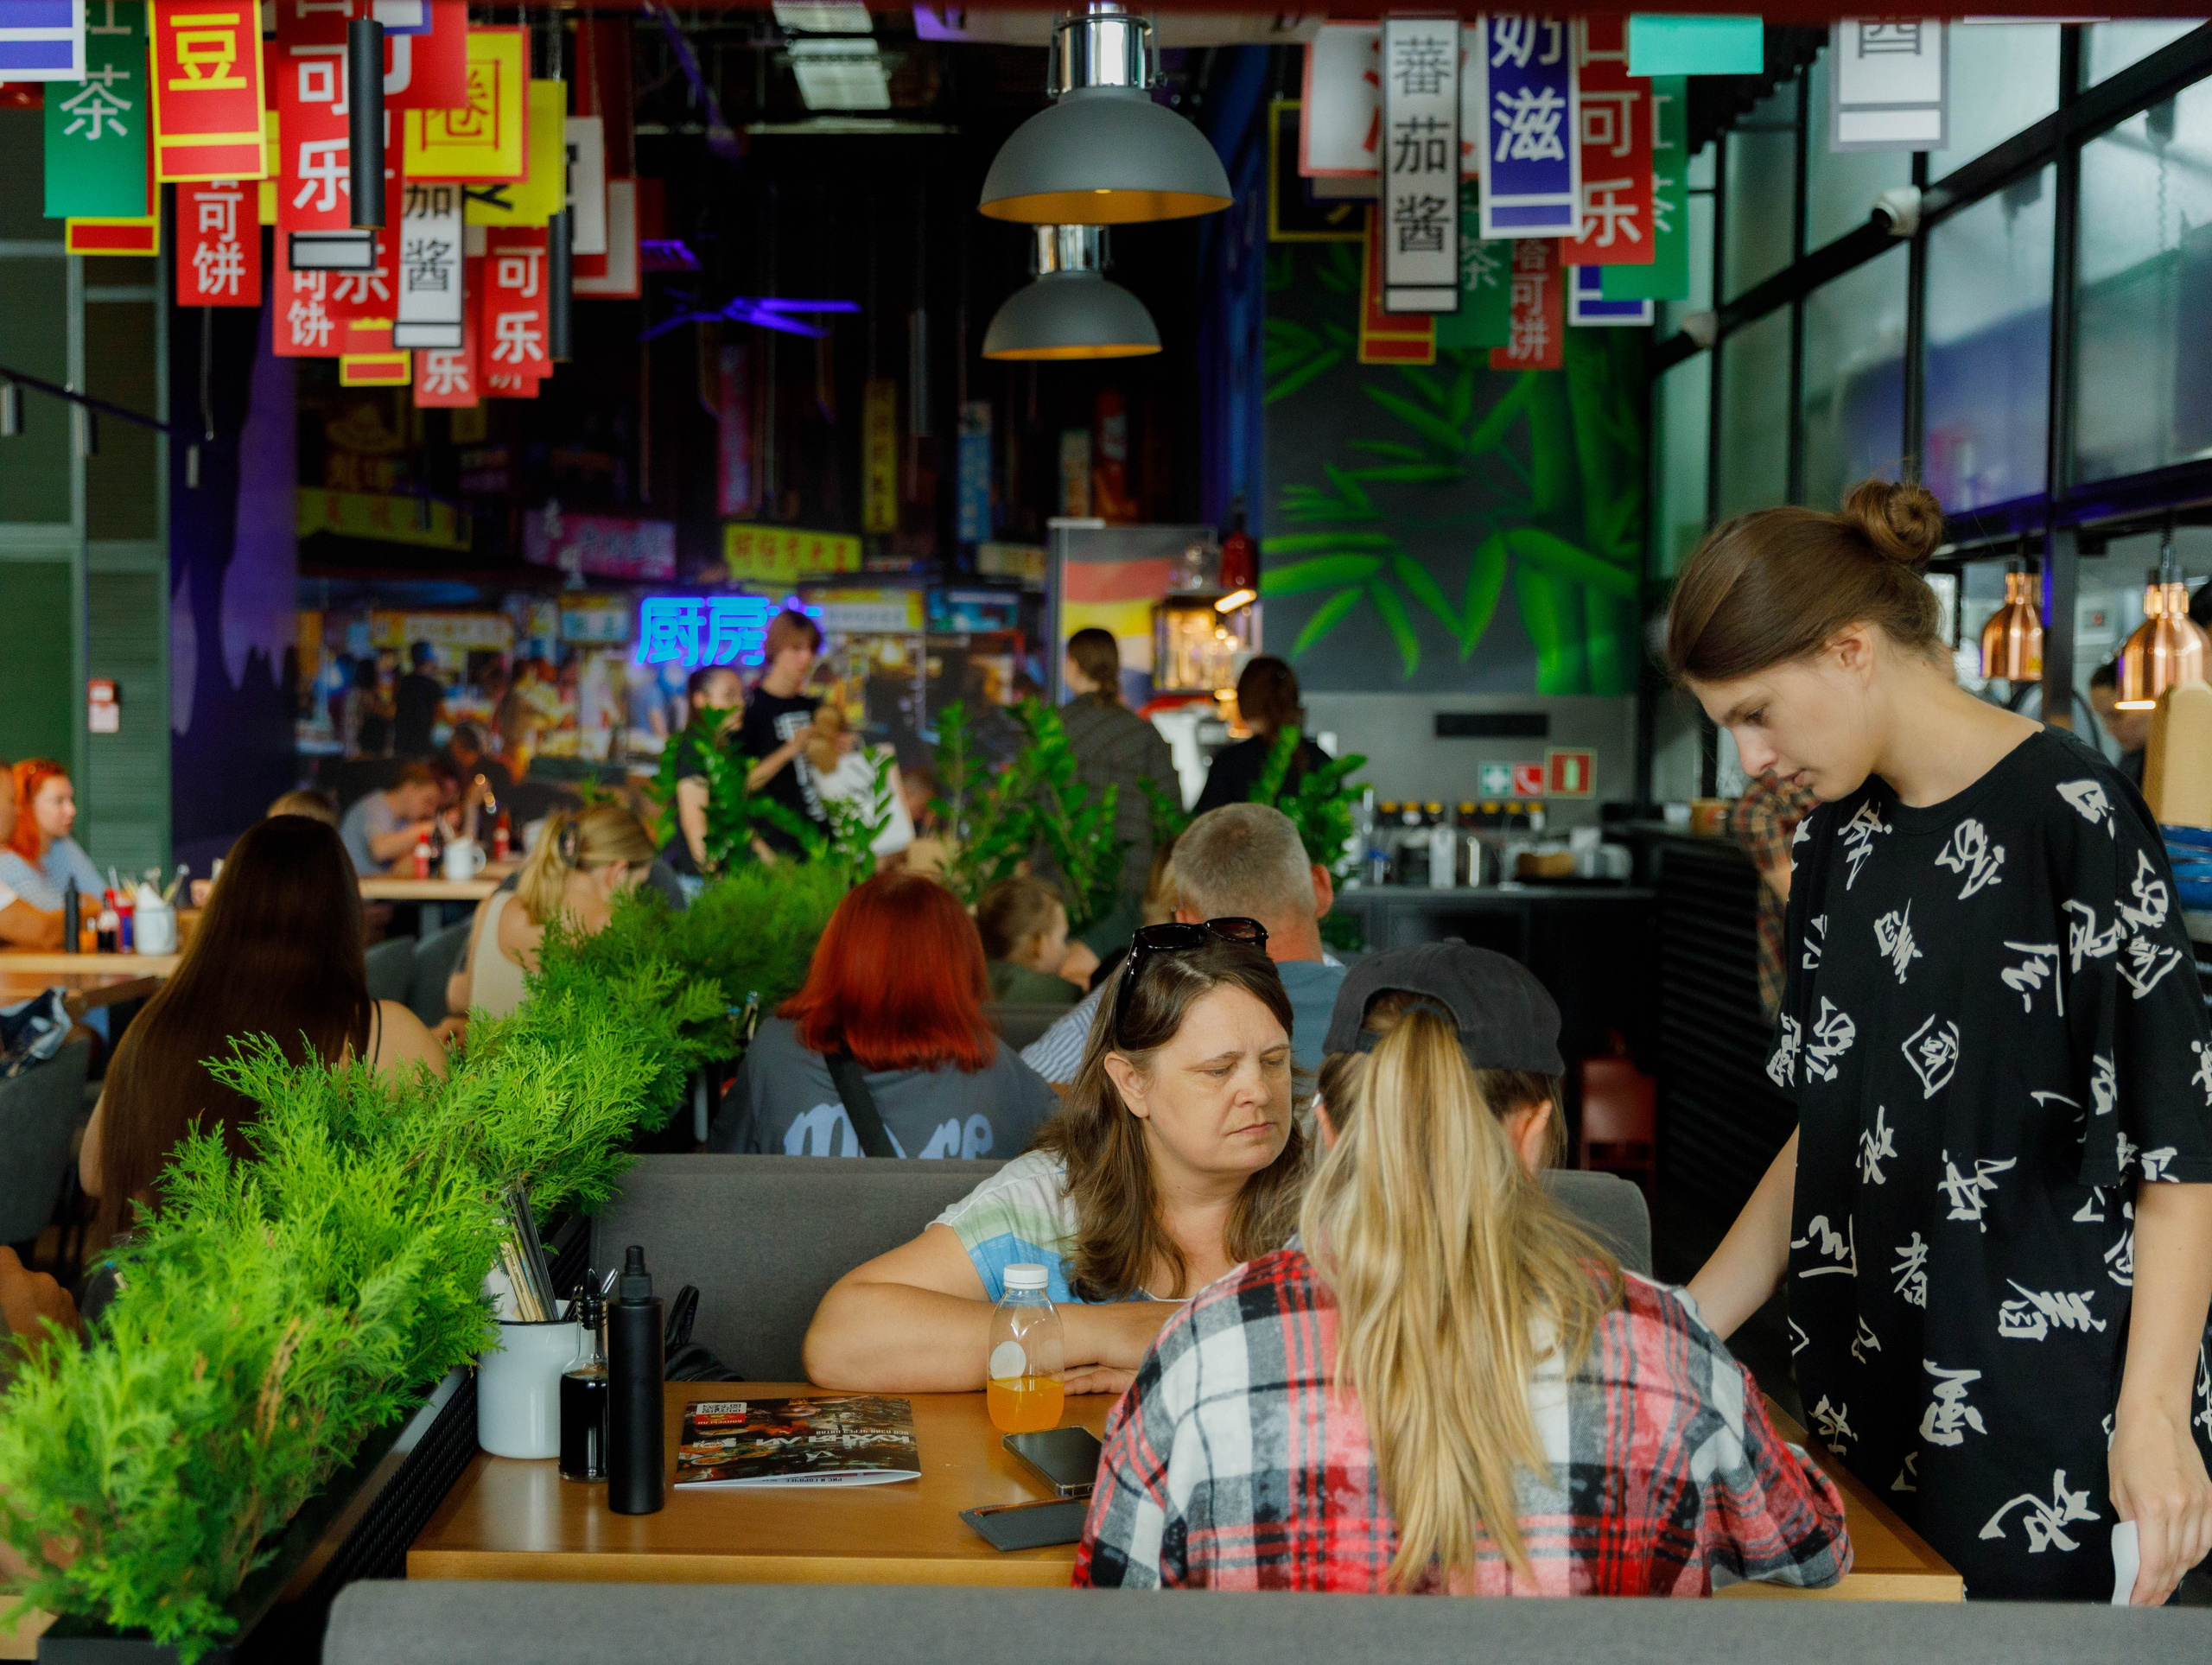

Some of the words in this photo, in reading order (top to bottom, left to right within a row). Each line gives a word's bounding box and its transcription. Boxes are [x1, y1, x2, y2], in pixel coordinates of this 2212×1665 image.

[168, 13, 248, 91] 豆
[491, 246, 546, 365] 可乐
[634, 596, 822, 667] 厨房
